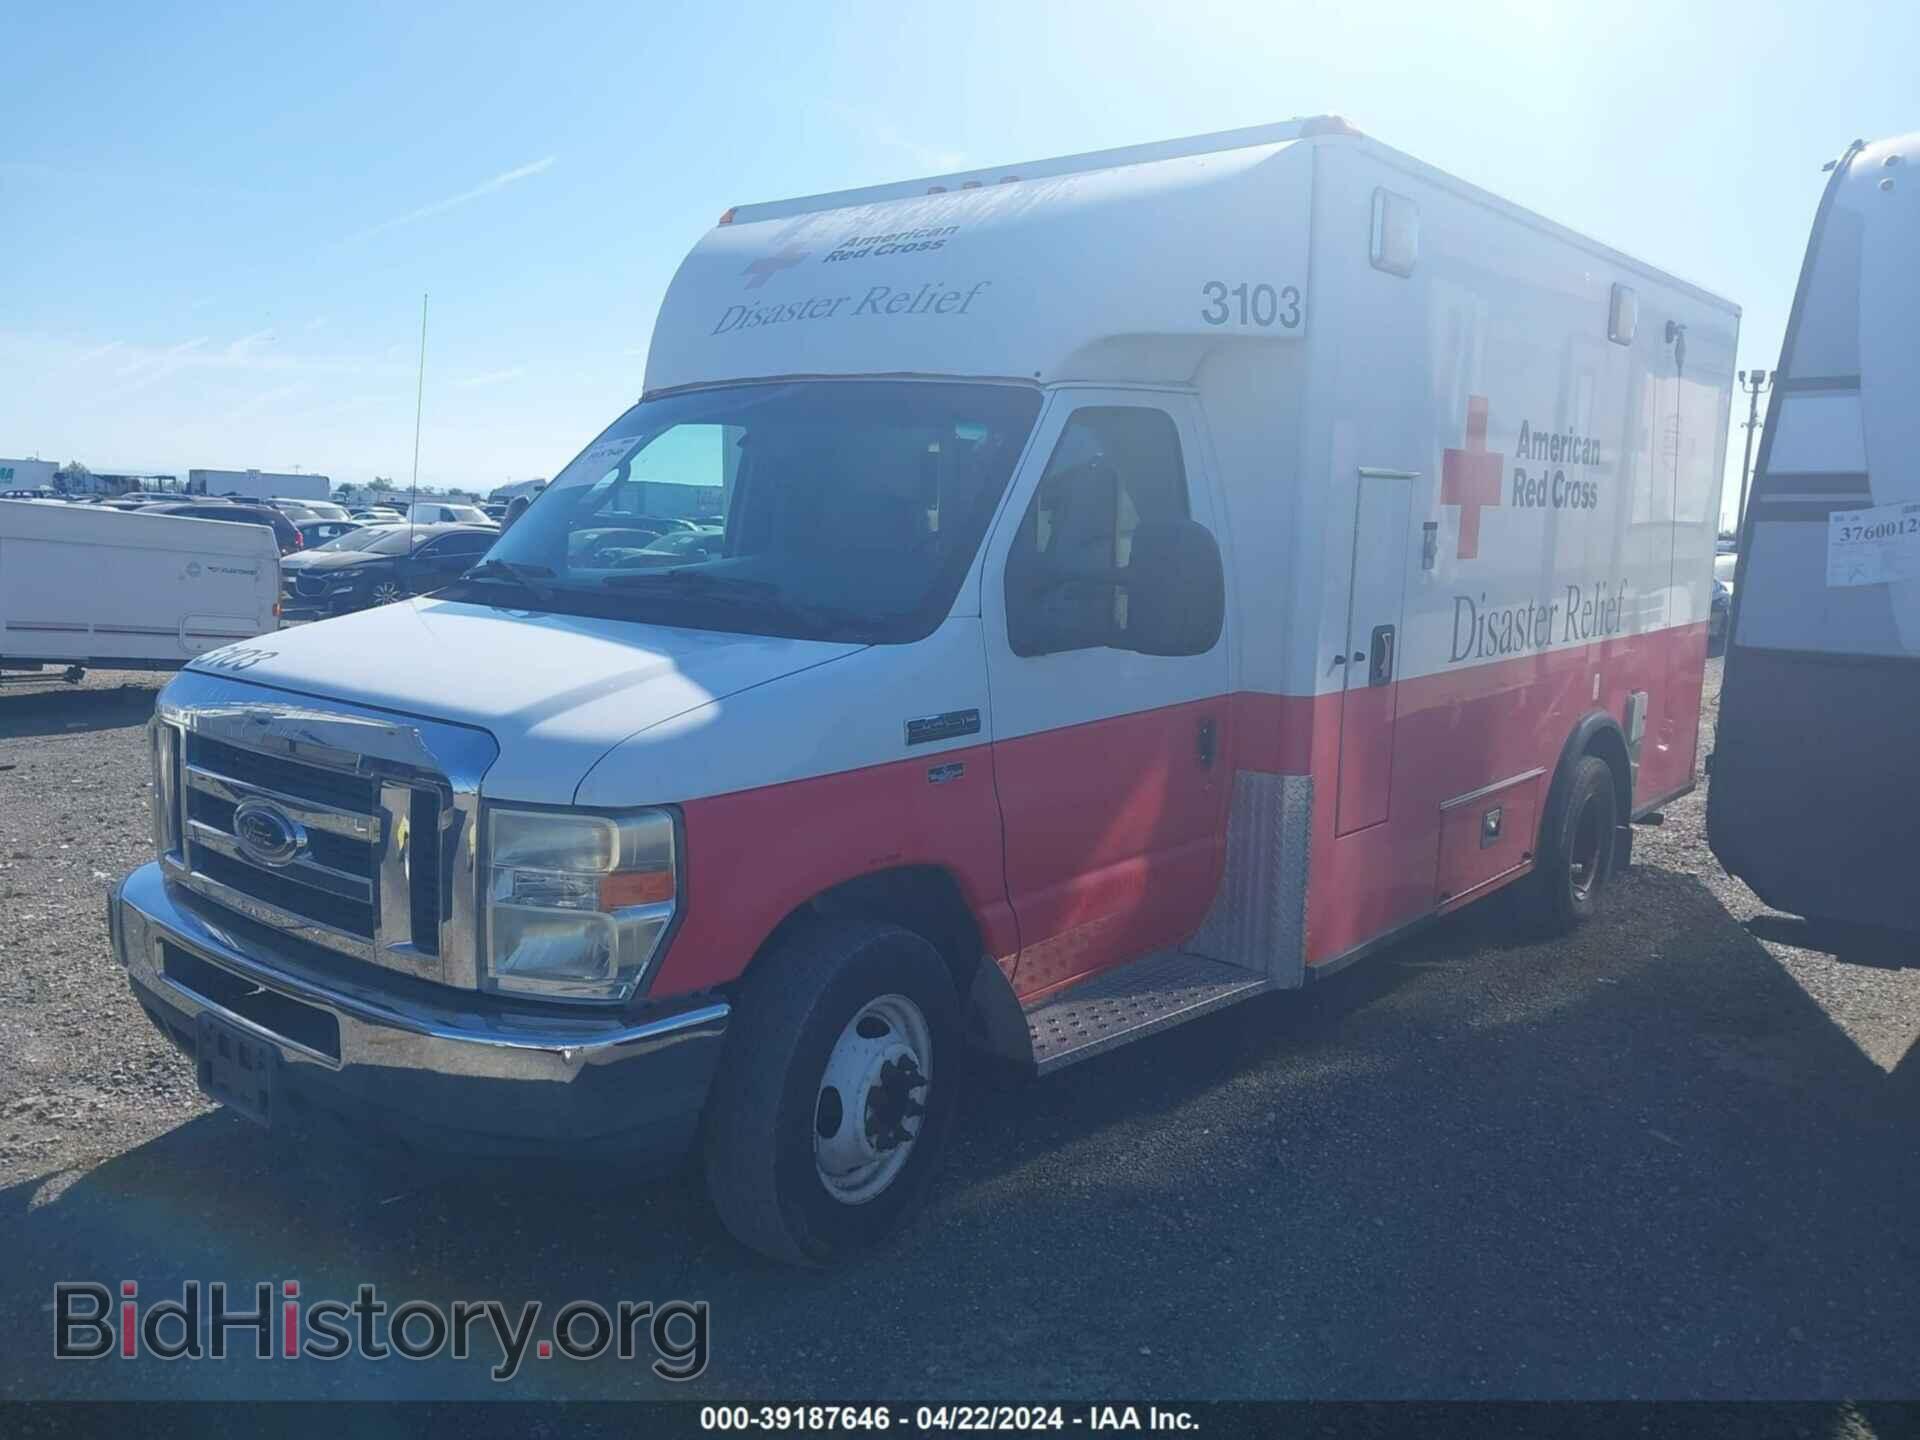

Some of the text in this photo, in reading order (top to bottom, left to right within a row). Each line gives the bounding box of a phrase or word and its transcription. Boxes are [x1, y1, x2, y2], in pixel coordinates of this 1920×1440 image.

[822, 239, 948, 263] Red Cross
[836, 225, 960, 249] American
[710, 280, 992, 336] Disaster Relief
[1201, 280, 1301, 329] 3103
[1516, 420, 1600, 466] American
[1512, 468, 1598, 510] Red Cross
[1839, 518, 1920, 542] 3760012
[1448, 578, 1628, 664] Disaster Relief
